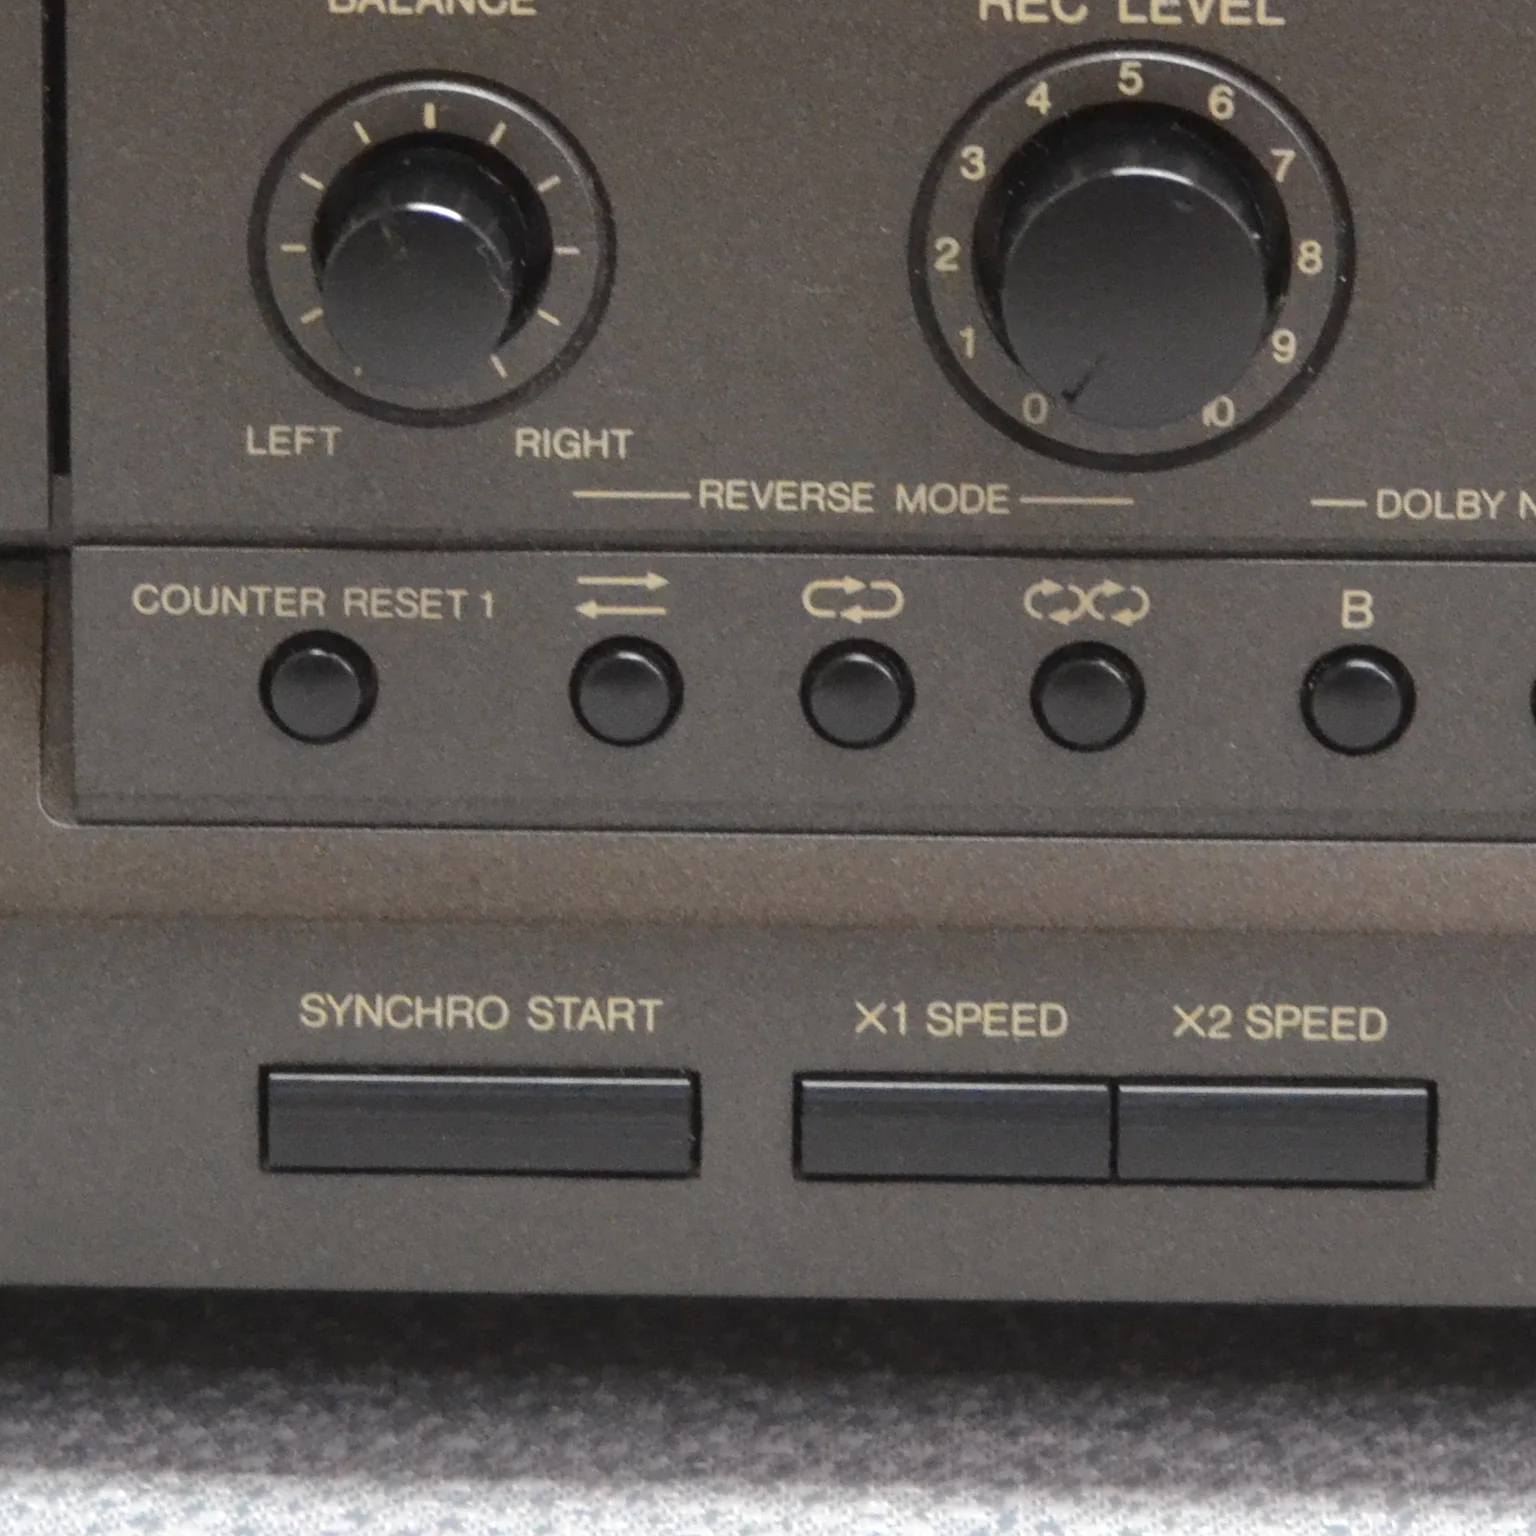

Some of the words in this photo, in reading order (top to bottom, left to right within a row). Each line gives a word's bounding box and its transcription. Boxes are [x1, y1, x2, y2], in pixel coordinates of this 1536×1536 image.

[1118, 60, 1143, 96] 5
[1025, 80, 1052, 115] 4
[1208, 83, 1235, 120] 6
[960, 144, 986, 181] 3
[1270, 147, 1297, 183] 7
[934, 236, 961, 273] 2
[1296, 239, 1323, 276] 8
[959, 326, 975, 359] 1
[1271, 328, 1297, 364] 9
[1021, 391, 1050, 426] 0
[245, 424, 341, 457] LEFT
[514, 426, 634, 460] RIGHT
[698, 478, 874, 514] REVERSE
[894, 482, 1010, 515] MODE
[1376, 488, 1506, 521] DOLBY
[131, 582, 326, 618] COUNTER
[343, 586, 469, 620] RESET
[480, 590, 494, 619] 1
[1340, 588, 1375, 630] B
[299, 992, 510, 1031] SYNCHRO
[527, 995, 664, 1033] START
[855, 1001, 907, 1035] X1
[925, 1000, 1069, 1038] SPEED
[1173, 1003, 1233, 1040] X2
[1245, 1003, 1388, 1042] SPEED
